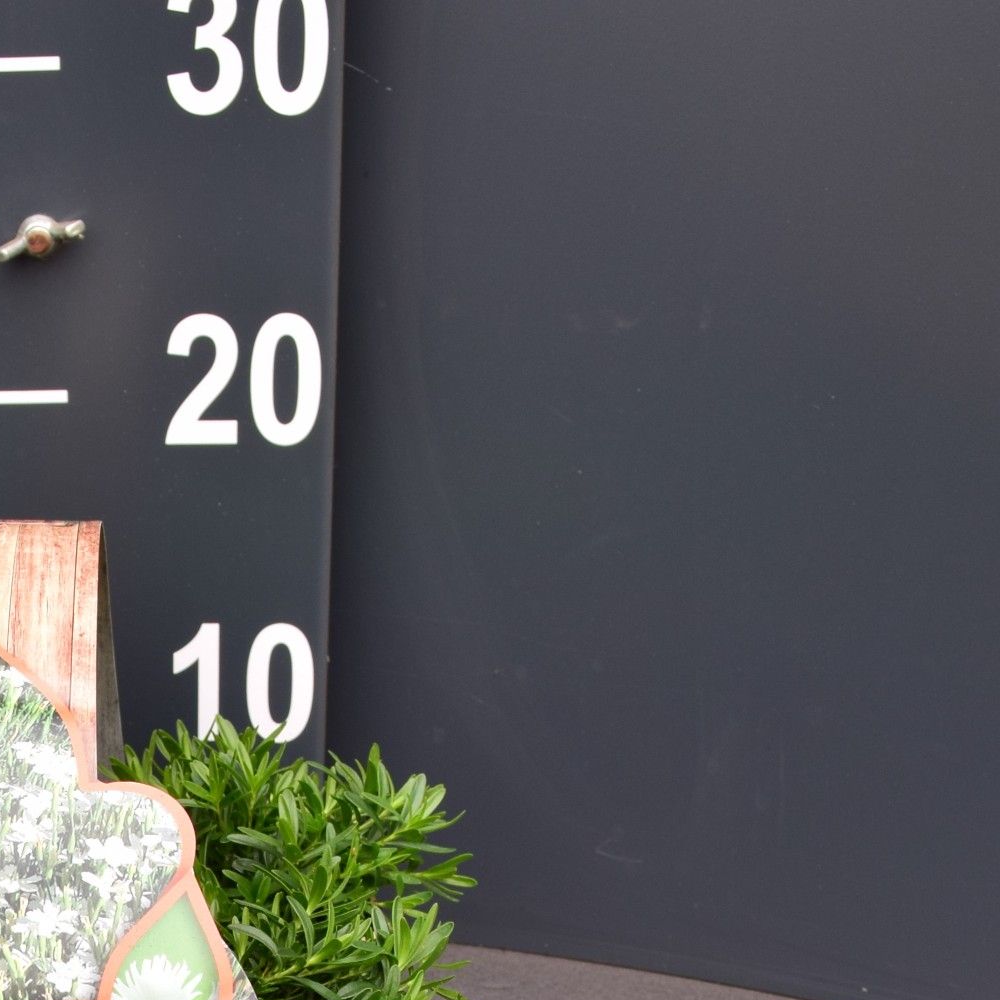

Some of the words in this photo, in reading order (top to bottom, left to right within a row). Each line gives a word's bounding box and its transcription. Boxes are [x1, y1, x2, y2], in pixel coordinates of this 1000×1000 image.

[166, 0, 330, 117] 30
[165, 312, 322, 446] 20
[172, 622, 315, 743] 10
